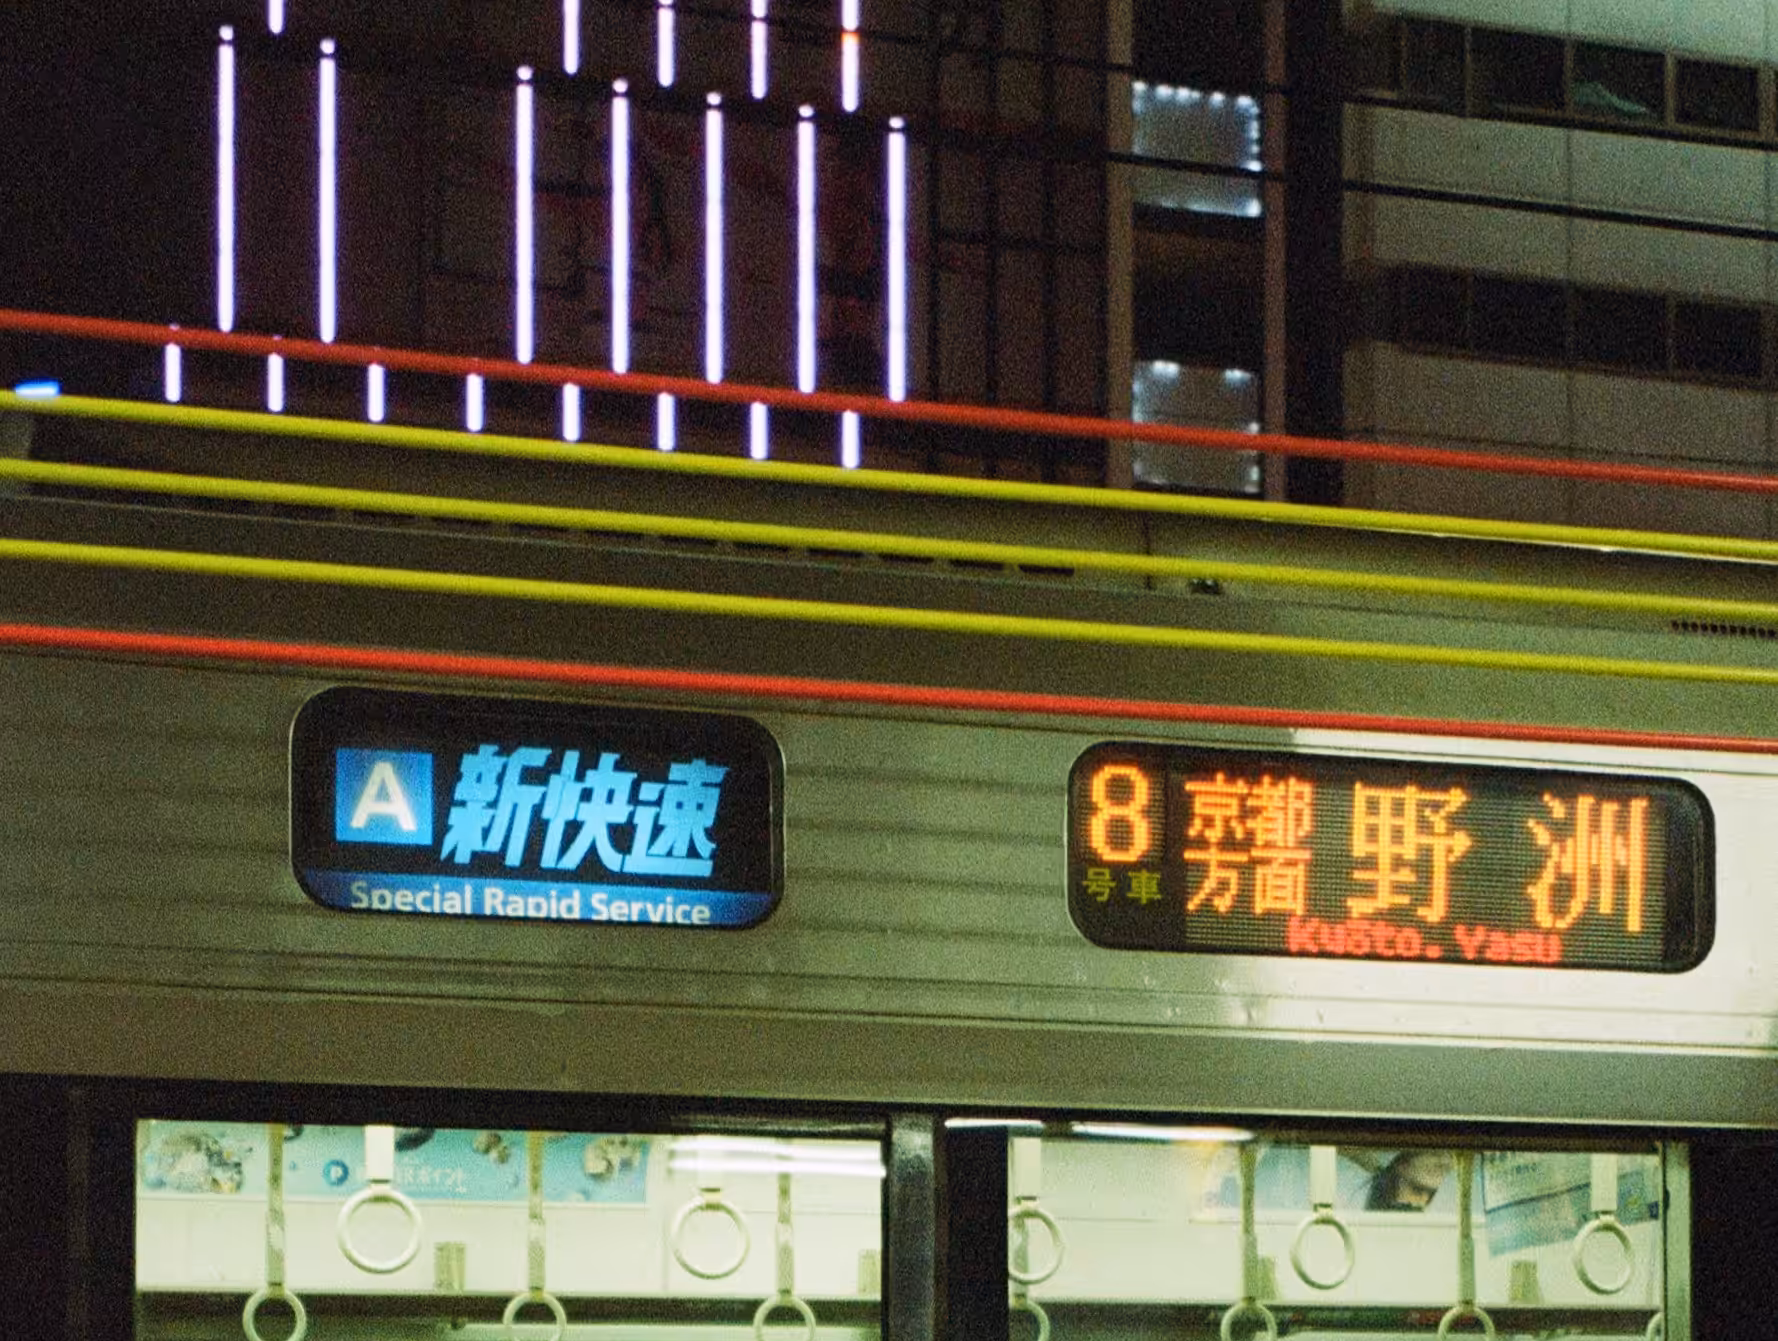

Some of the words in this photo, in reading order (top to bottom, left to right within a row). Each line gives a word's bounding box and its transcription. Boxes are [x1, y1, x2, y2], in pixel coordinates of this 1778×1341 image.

[350, 761, 417, 831] A
[440, 744, 729, 877] 新快速
[1090, 765, 1151, 862] 8
[1184, 772, 1314, 847] 京都
[1082, 867, 1162, 905] 号車
[1183, 846, 1313, 915] 方面
[1346, 780, 1649, 933] 野洲
[350, 881, 473, 915] Special
[483, 888, 581, 920] Rapid
[591, 893, 711, 926] Service
[1454, 923, 1562, 963] Yasu
